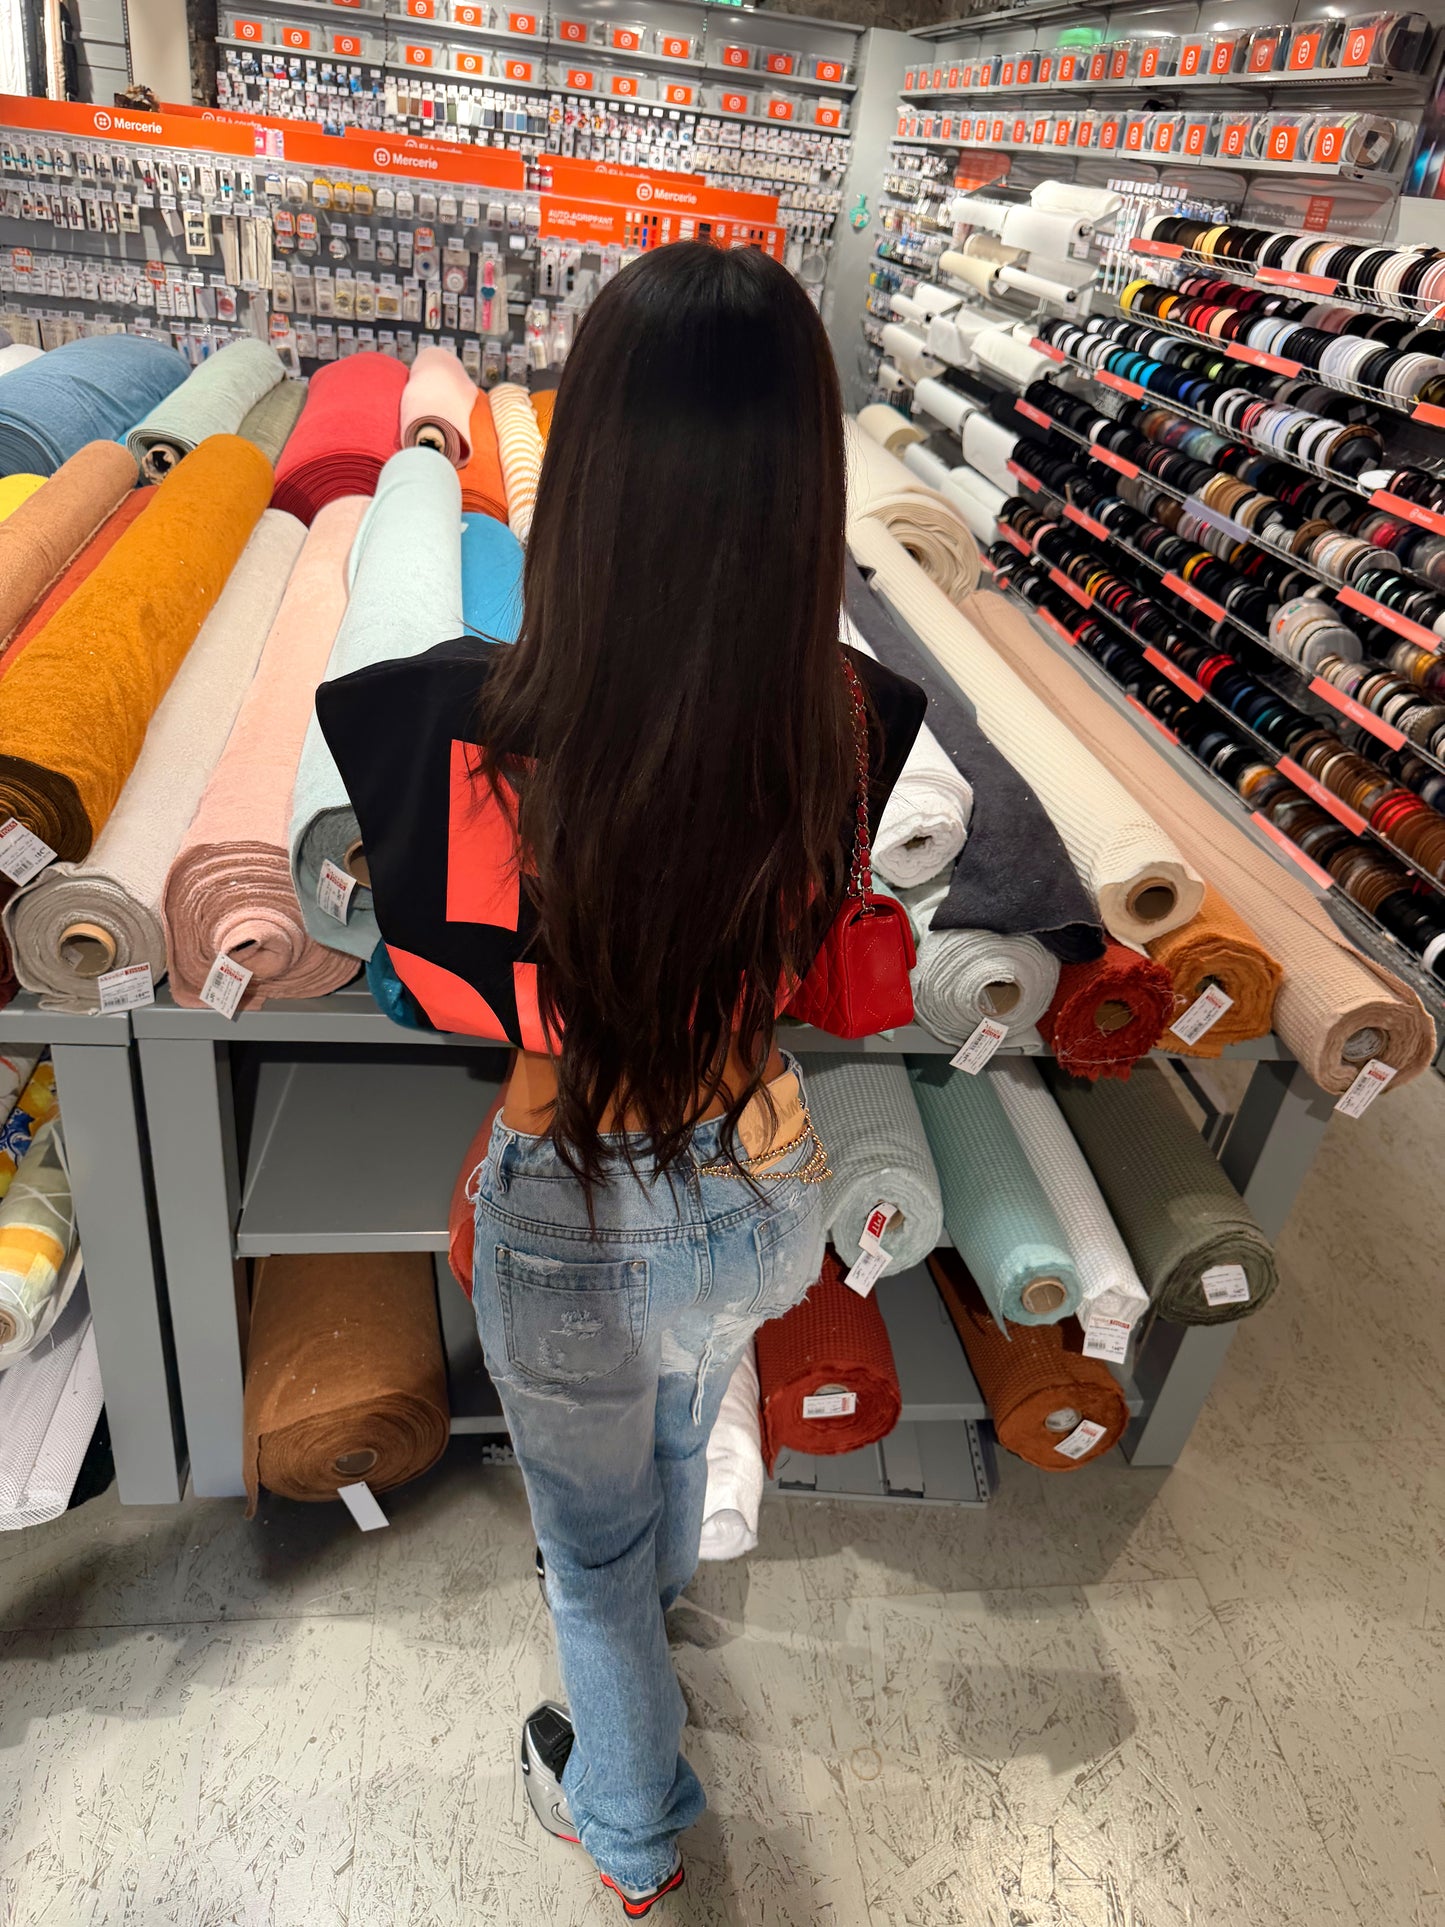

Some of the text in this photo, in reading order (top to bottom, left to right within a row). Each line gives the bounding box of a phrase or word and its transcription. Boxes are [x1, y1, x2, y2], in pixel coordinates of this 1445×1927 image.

[114, 116, 163, 134] Mercerie
[393, 153, 438, 170] Mercerie
[654, 188, 697, 205] Mercerie
